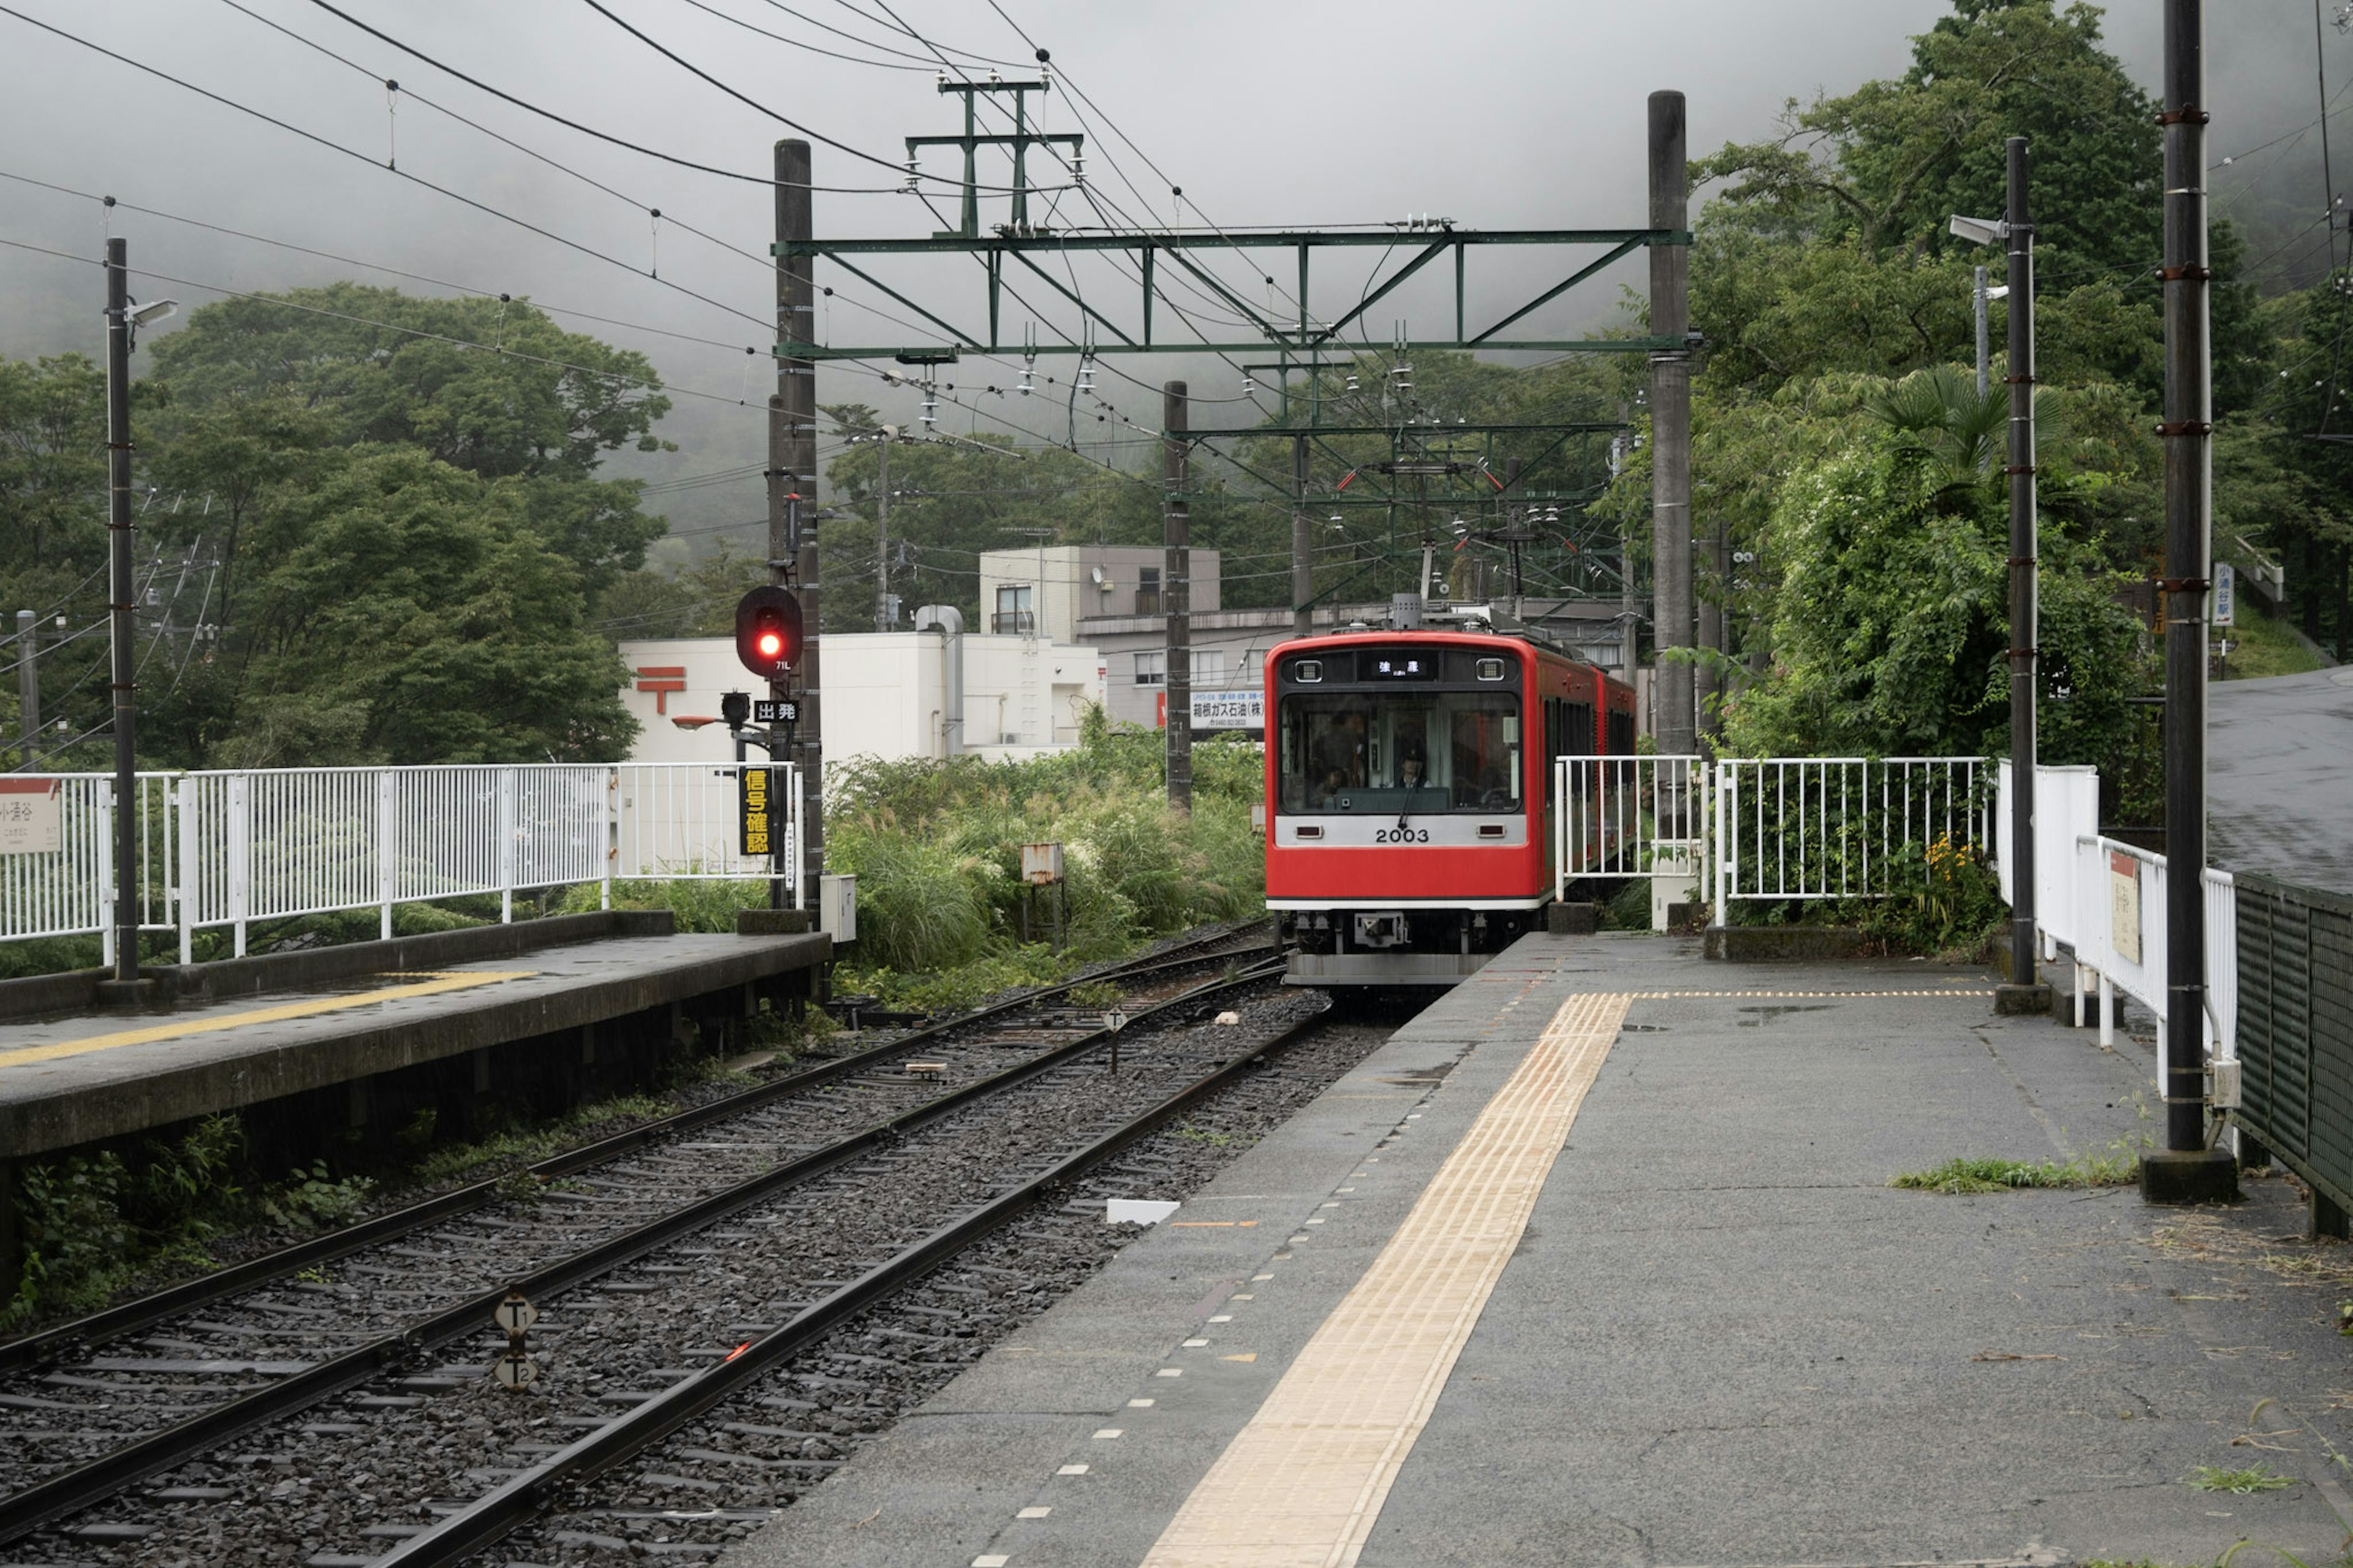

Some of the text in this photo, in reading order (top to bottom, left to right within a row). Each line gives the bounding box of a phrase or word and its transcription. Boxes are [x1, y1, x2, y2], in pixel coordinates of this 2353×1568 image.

[2217, 566, 2230, 615] 小涌谷駅
[776, 661, 791, 670] 71L
[758, 703, 796, 721] 出発
[745, 770, 769, 854] 信号確認
[1376, 829, 1430, 843] 2003
[1109, 1013, 1123, 1026] T3
[504, 1301, 528, 1327] T1
[504, 1358, 529, 1384] T2
